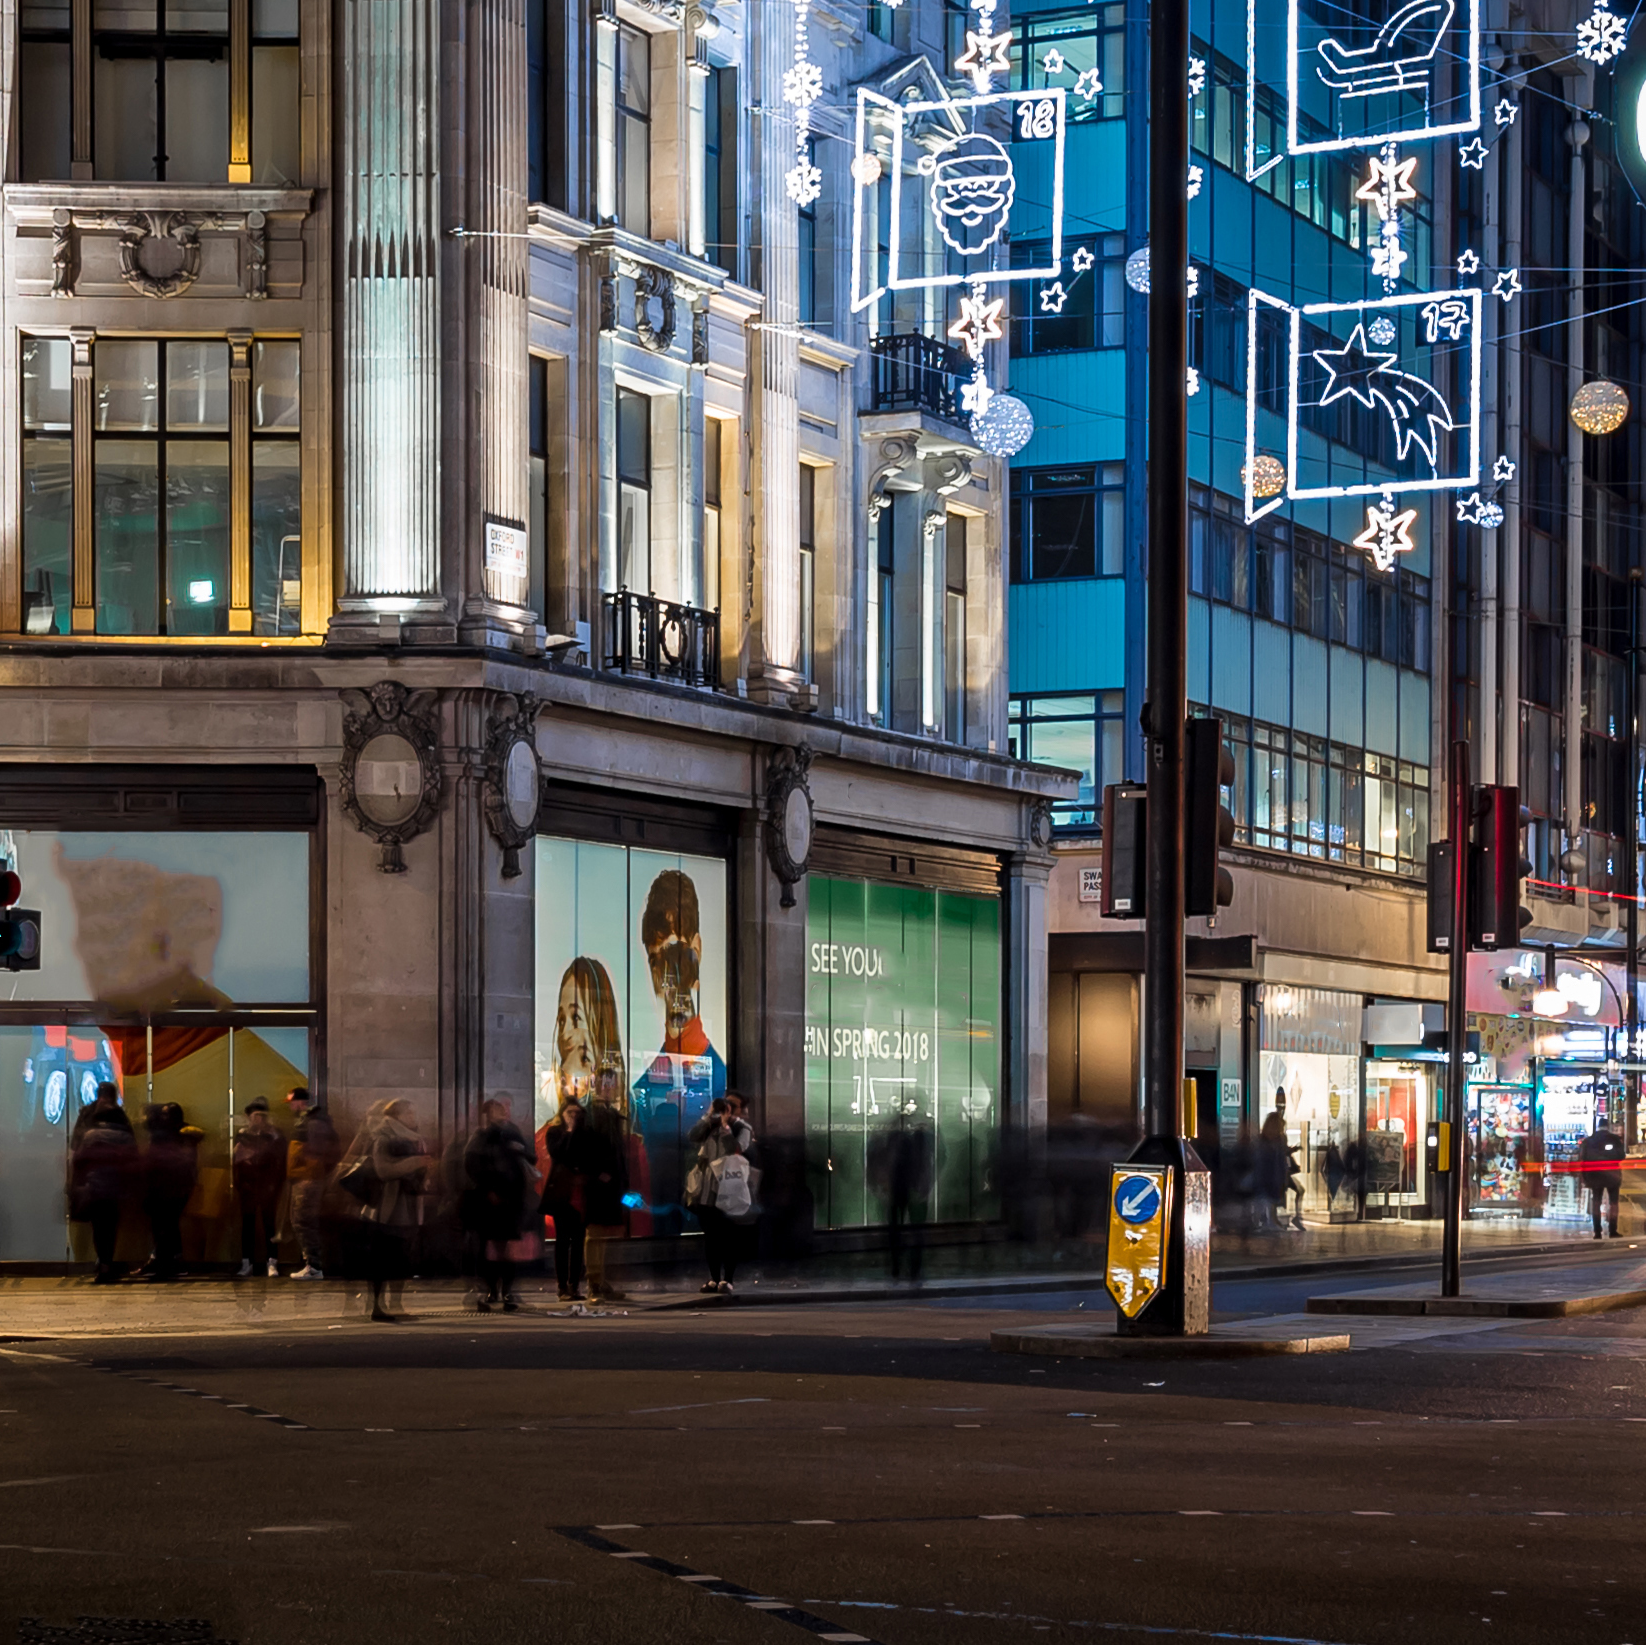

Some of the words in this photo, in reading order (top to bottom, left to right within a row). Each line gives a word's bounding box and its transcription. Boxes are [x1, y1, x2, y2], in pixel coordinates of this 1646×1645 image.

[1017, 99, 1055, 138] 18
[1421, 301, 1470, 343] 17
[490, 527, 515, 545] OXFORD
[811, 942, 839, 974] SEE
[832, 1027, 890, 1060] SPRING
[893, 1030, 929, 1062] 2018
